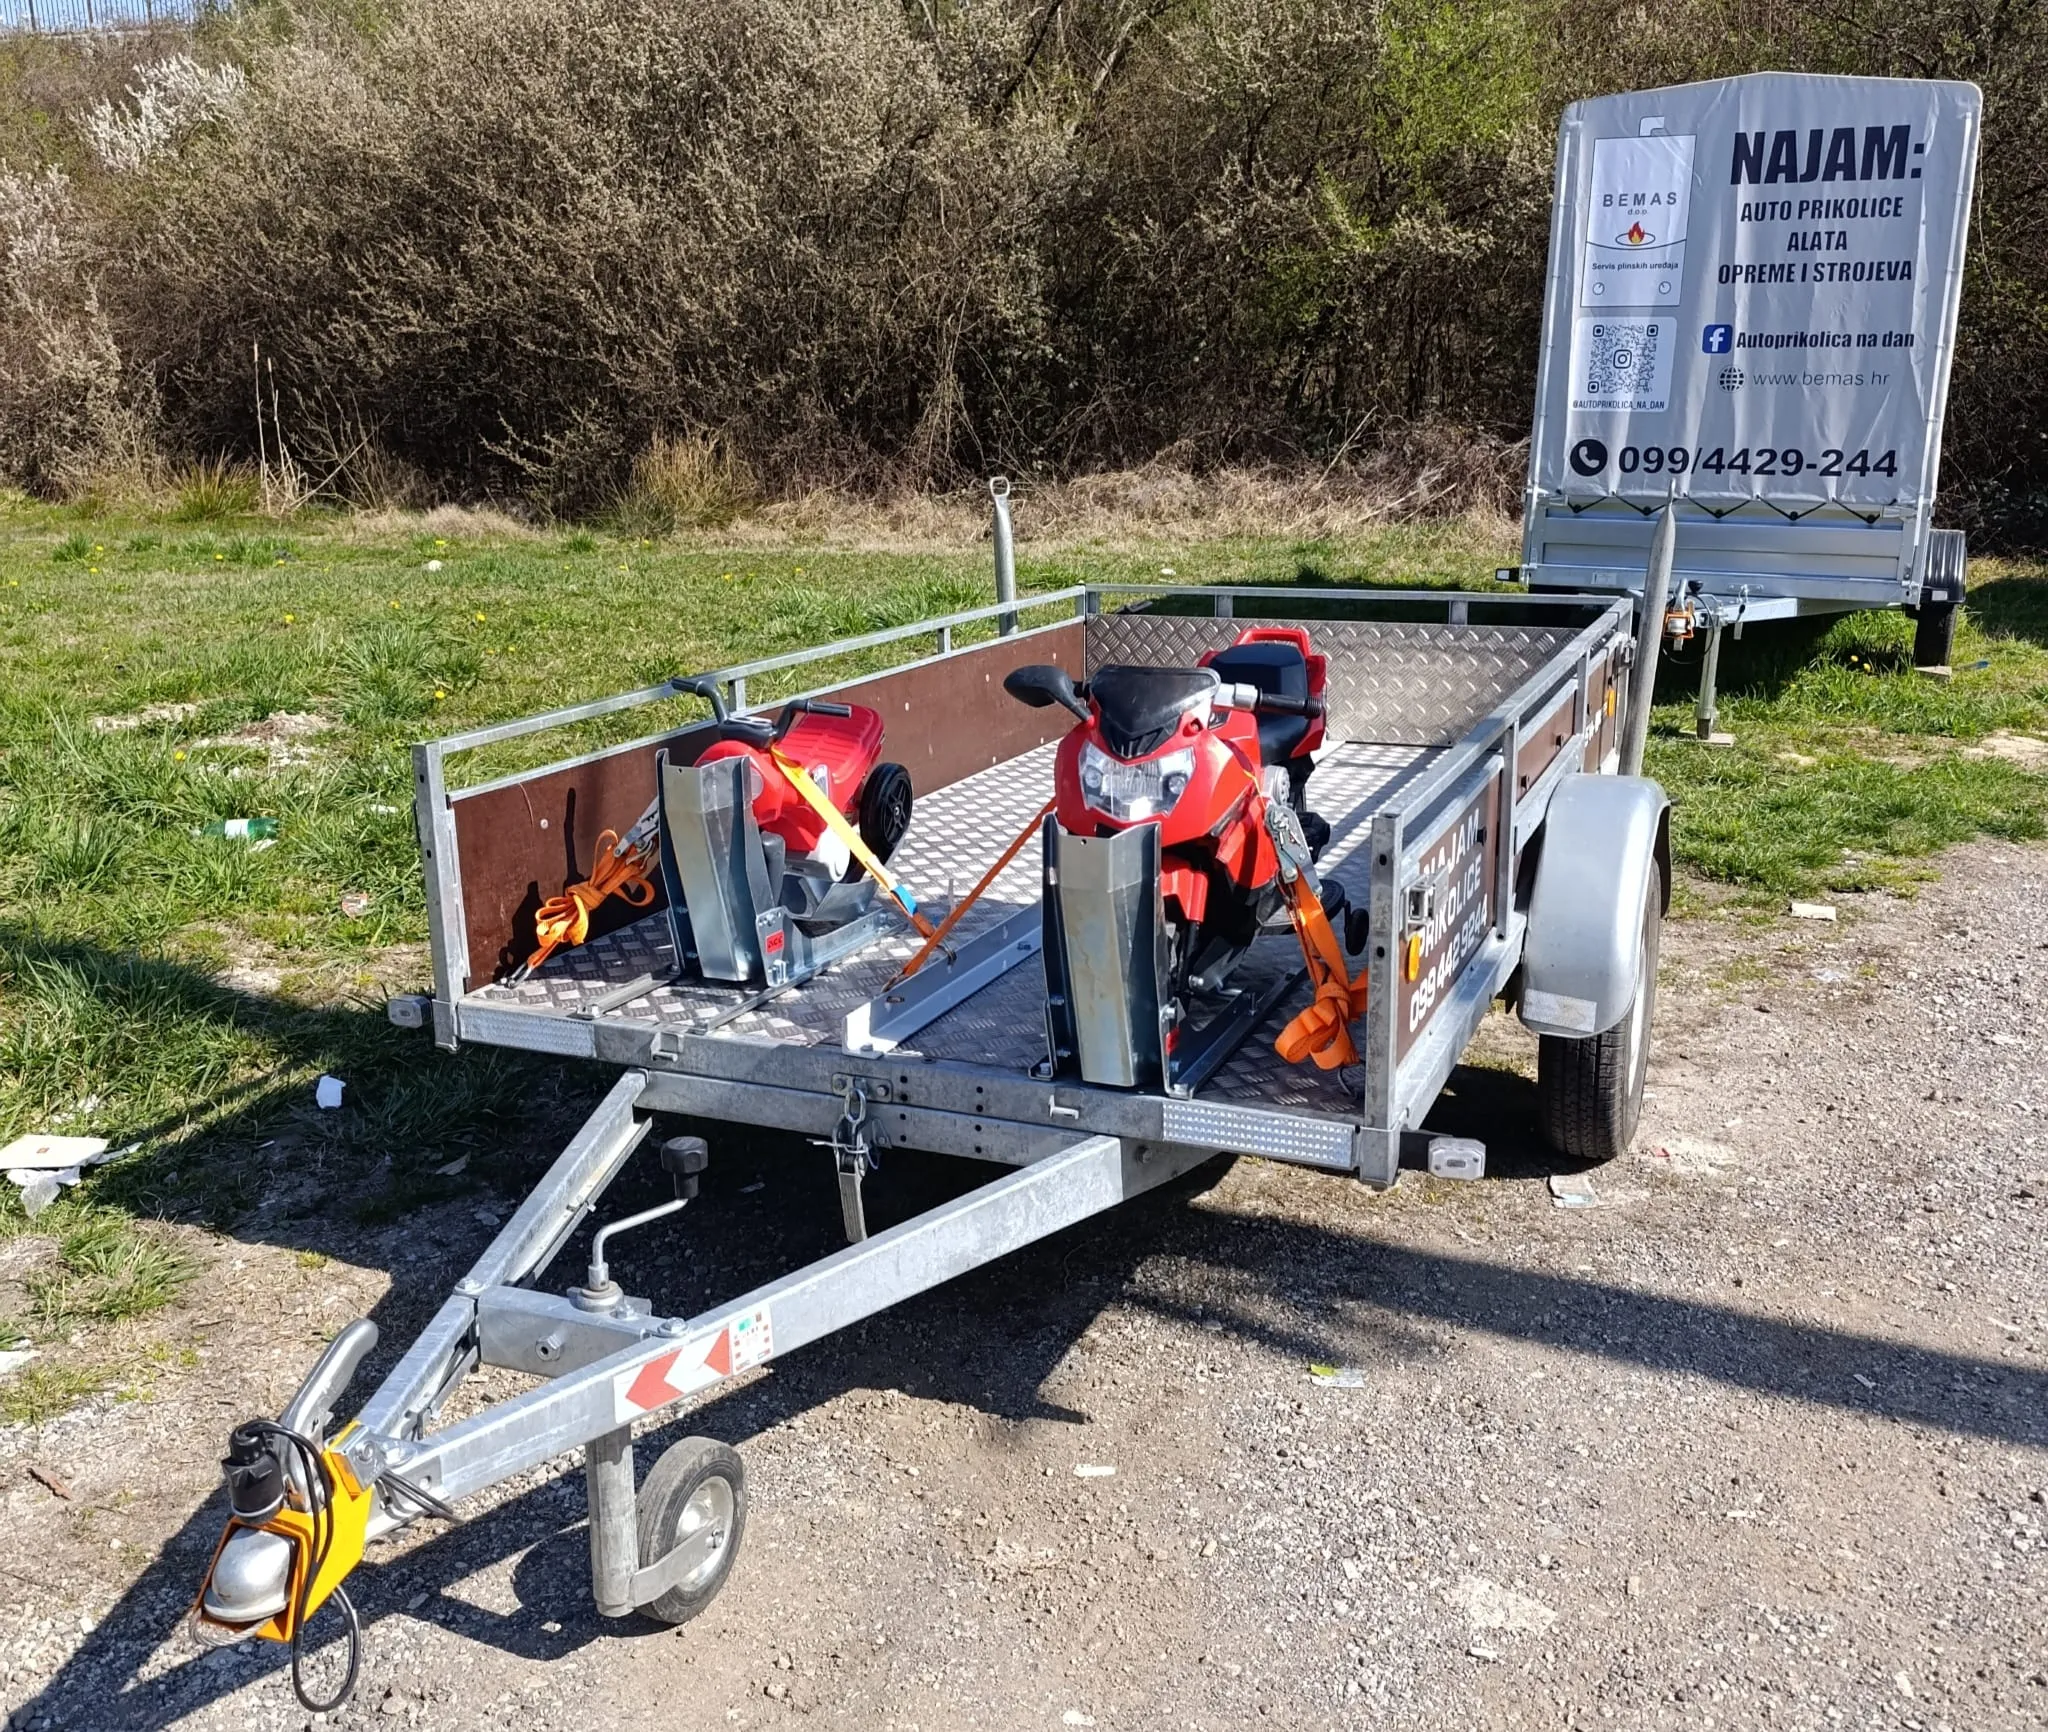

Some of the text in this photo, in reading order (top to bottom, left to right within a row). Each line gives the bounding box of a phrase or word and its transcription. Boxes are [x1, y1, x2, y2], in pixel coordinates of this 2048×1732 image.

[1731, 124, 1925, 185] NAJAM:
[1602, 191, 1678, 208] BEMAS
[1740, 197, 1904, 222] AUTO PRIKOLICE
[1786, 230, 1848, 252] ALATA
[1592, 262, 1616, 270] Servis
[1617, 262, 1648, 272] plinskih
[1718, 260, 1912, 285] OPREME I STROJEVA
[1736, 330, 1852, 350] Autoprikolica
[1856, 332, 1878, 348] na
[1881, 330, 1915, 348] dan
[1752, 370, 1891, 387] www.bemas.hr
[1618, 446, 1898, 477] 099/4429-244
